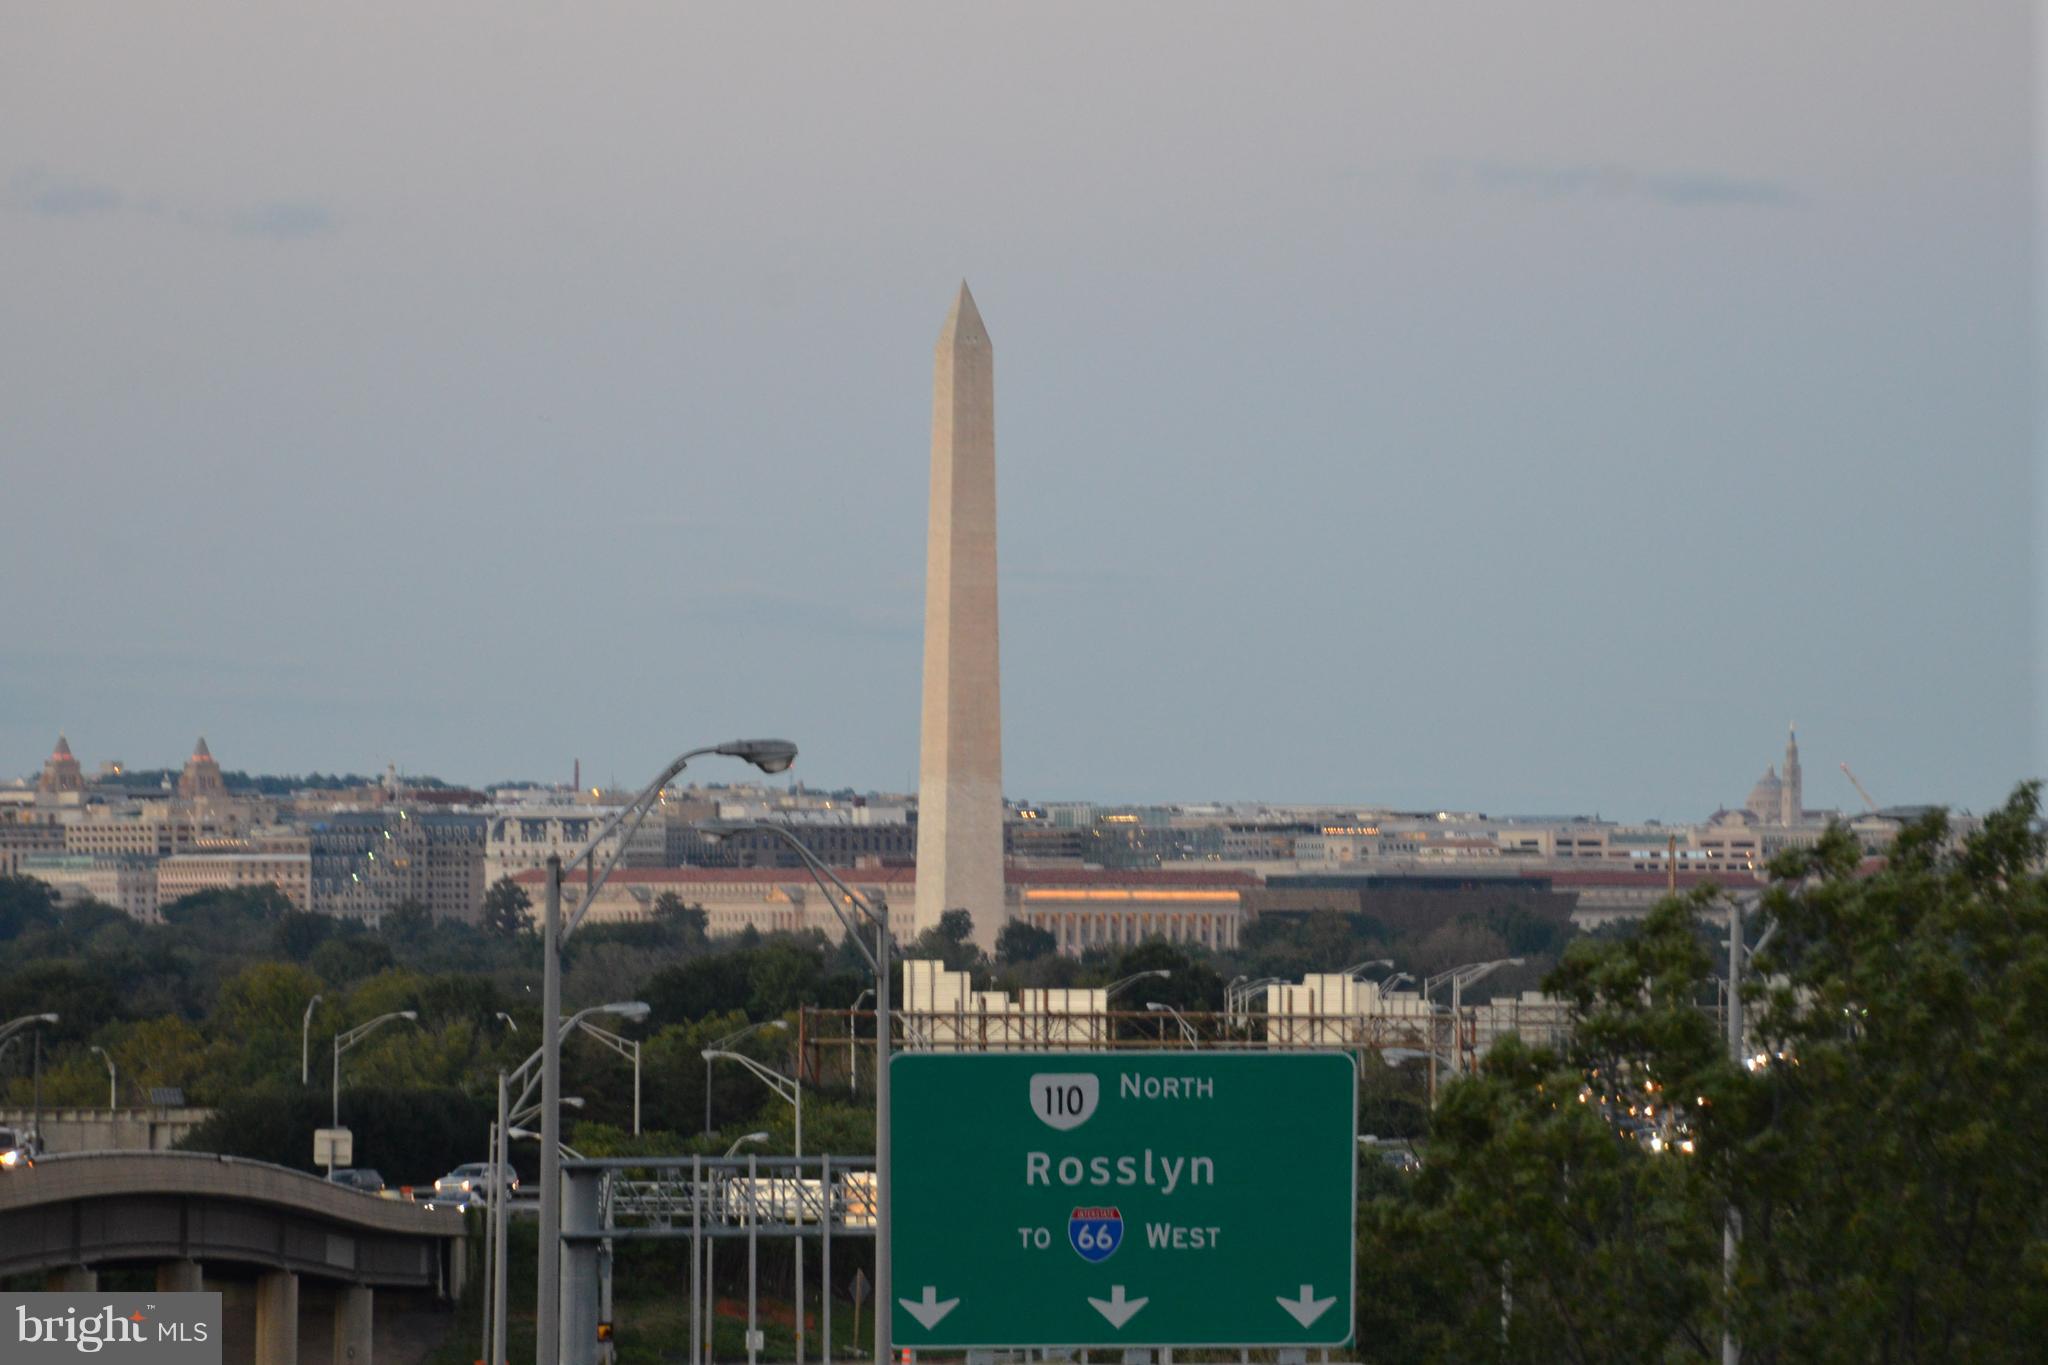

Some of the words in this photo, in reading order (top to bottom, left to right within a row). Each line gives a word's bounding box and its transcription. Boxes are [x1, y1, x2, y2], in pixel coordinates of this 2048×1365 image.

[1044, 1085, 1084, 1116] 110
[1119, 1072, 1214, 1099] NORTH
[1026, 1149, 1215, 1195] Rosslyn
[1018, 1227, 1051, 1249] TO
[1077, 1224, 1113, 1249] 66
[1146, 1222, 1221, 1249] WEST
